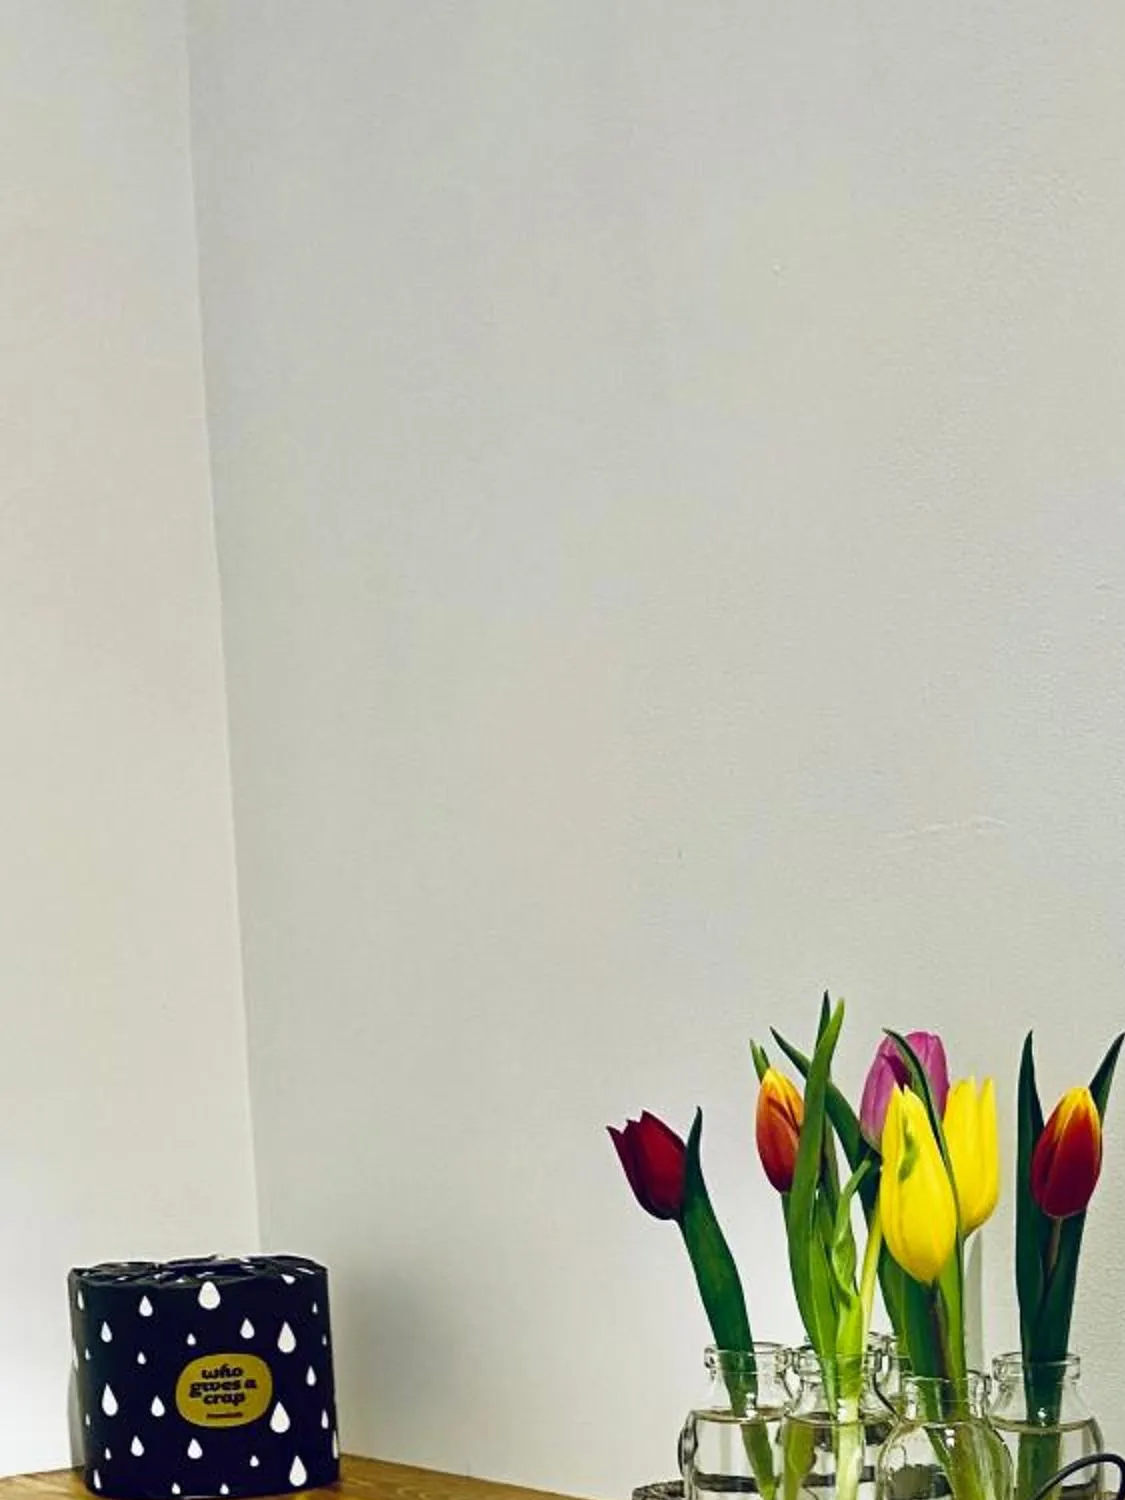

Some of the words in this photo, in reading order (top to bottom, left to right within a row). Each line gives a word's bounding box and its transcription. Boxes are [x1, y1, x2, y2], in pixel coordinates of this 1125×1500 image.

[202, 1364, 243, 1379] who
[189, 1380, 241, 1398] gives
[244, 1379, 257, 1389] a
[203, 1392, 245, 1406] crap
